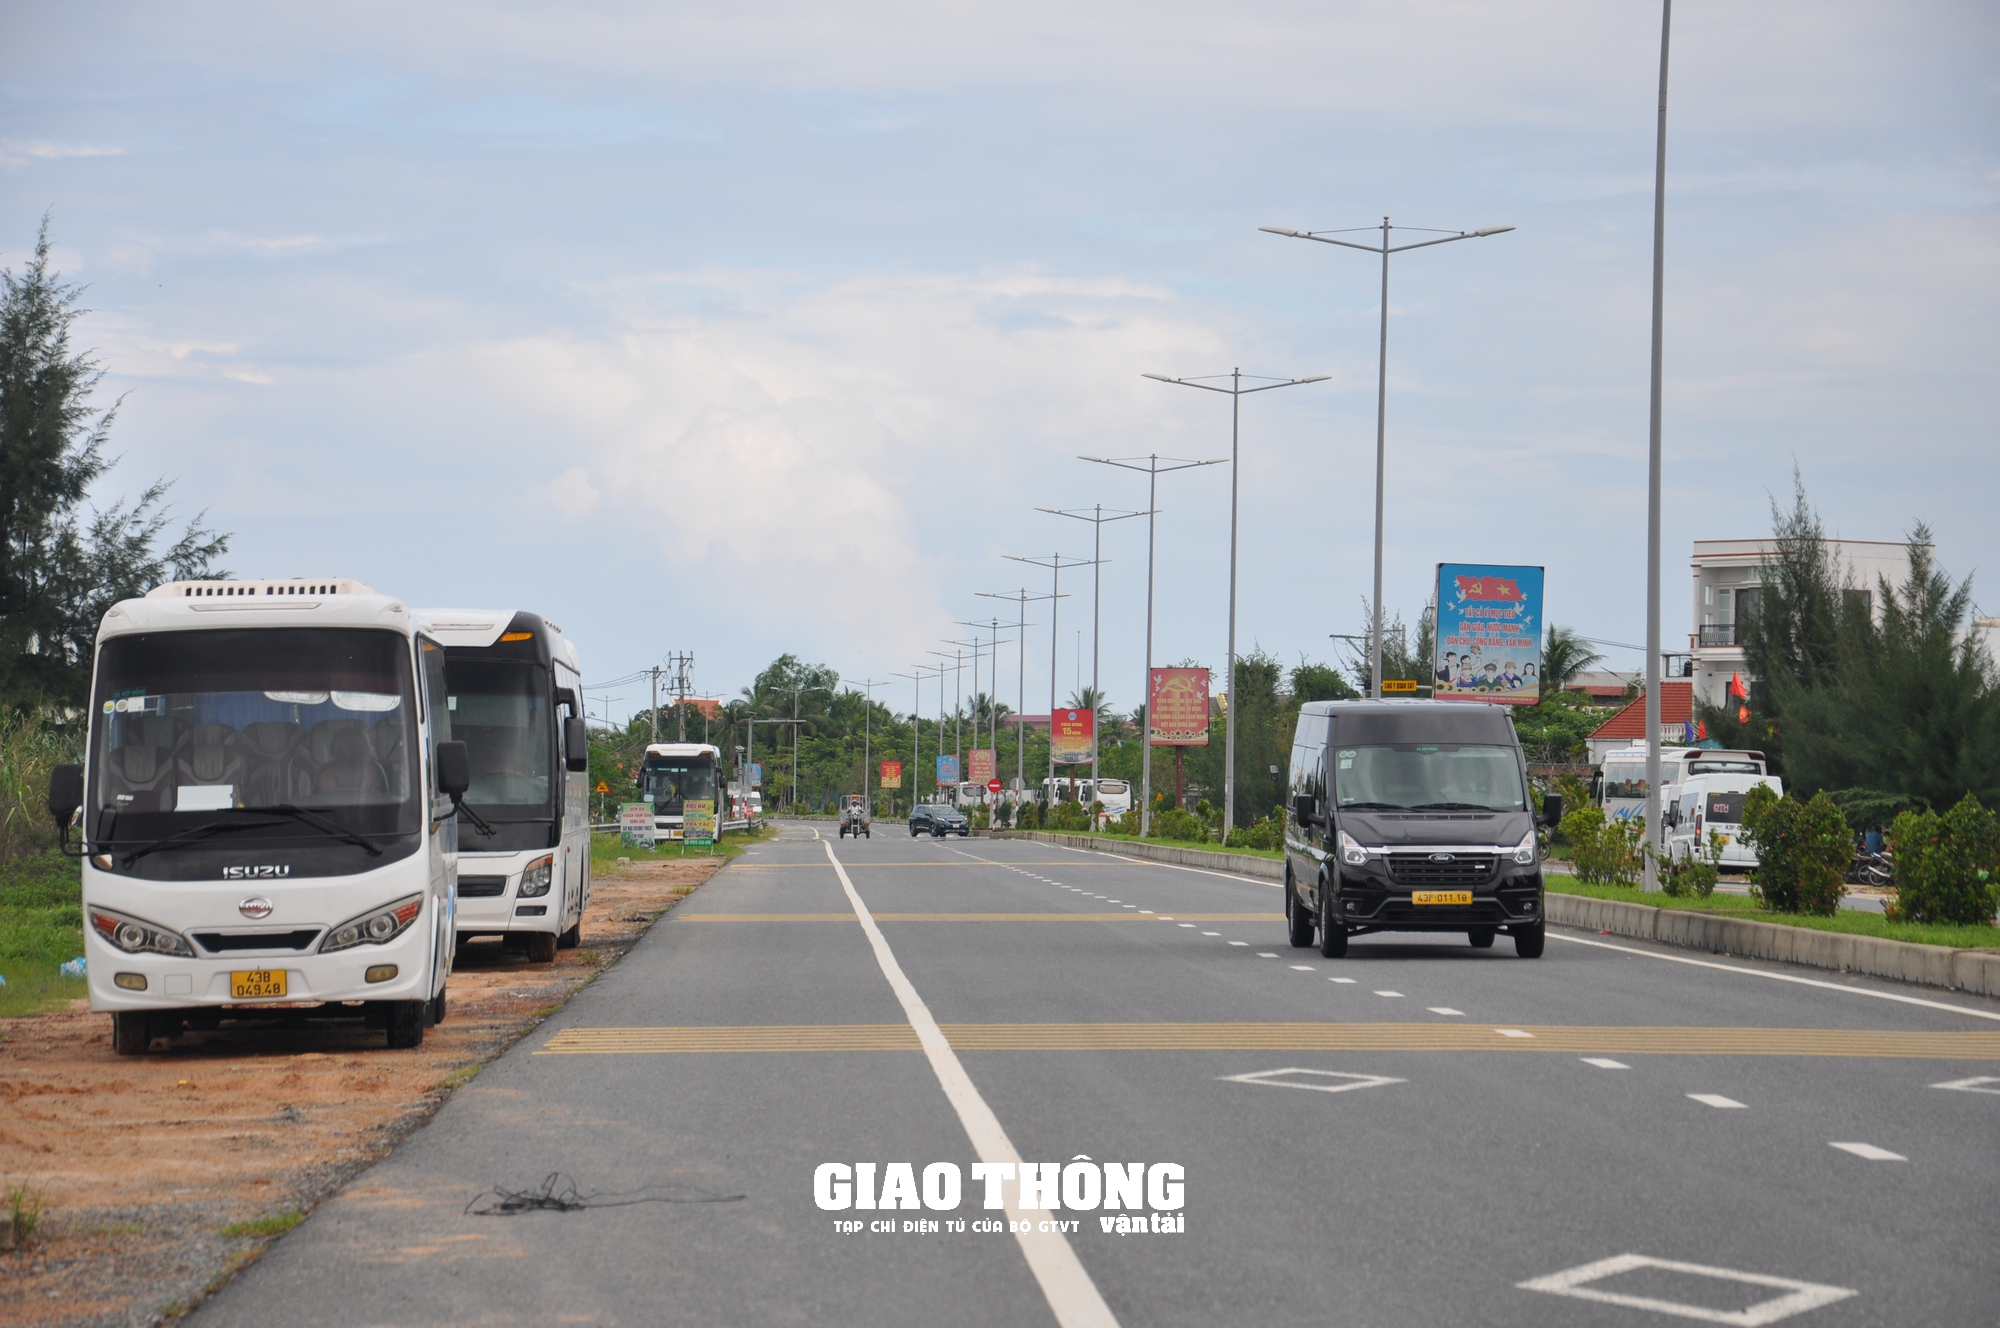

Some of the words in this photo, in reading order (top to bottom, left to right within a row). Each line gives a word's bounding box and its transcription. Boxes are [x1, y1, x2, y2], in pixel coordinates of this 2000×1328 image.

[1466, 605, 1474, 618] TẤT
[1476, 606, 1483, 618] CẢ
[1484, 606, 1490, 618] VÌ
[1491, 608, 1502, 620] MỤC
[1504, 608, 1516, 619] TIÊU
[1460, 620, 1470, 632] DÂN
[1487, 621, 1501, 632] NƯỚC
[1447, 634, 1458, 645] DÂN
[1473, 636, 1487, 647] CÔNG
[1506, 636, 1516, 647] VĂN
[1518, 638, 1532, 648] MINH
[223, 865, 290, 879] ISUZU
[247, 971, 270, 983] 43B
[237, 983, 280, 996] 049.48
